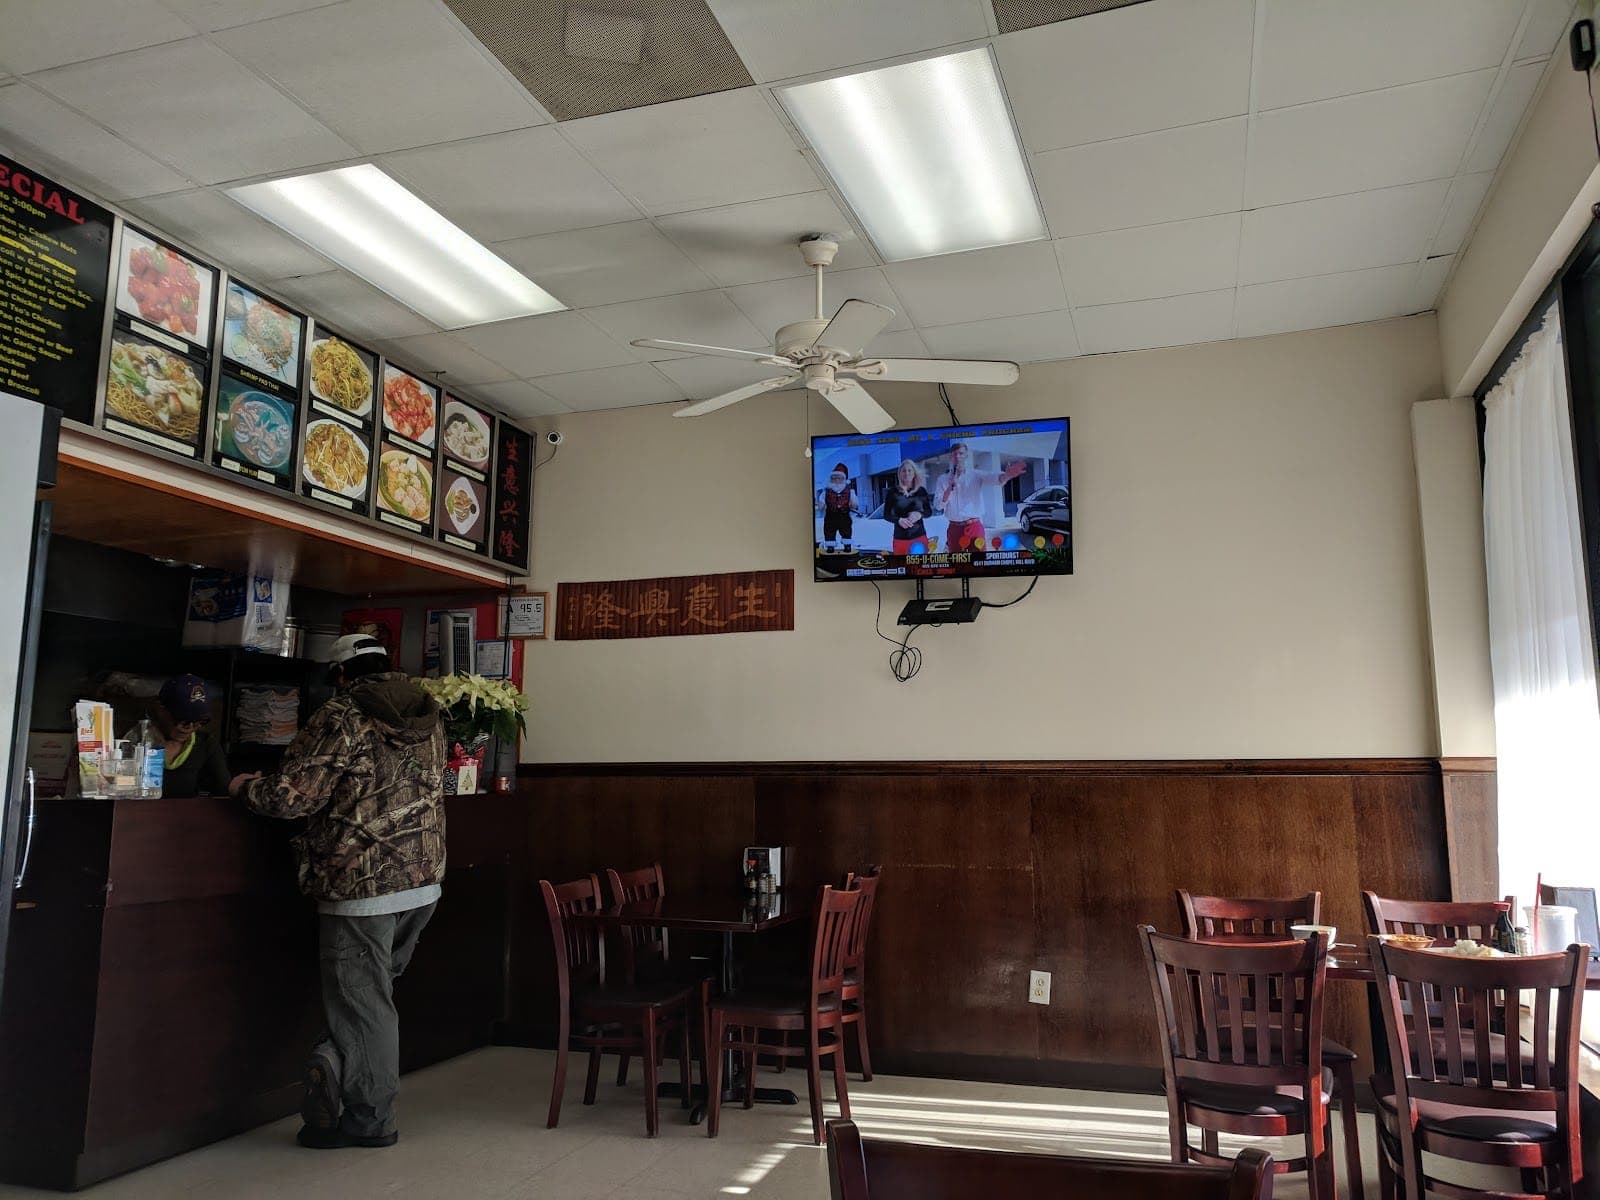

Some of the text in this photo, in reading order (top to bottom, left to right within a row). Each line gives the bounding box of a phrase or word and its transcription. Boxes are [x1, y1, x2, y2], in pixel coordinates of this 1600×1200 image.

[12, 196, 46, 220] 3:00pm
[19, 233, 50, 251] Chicken
[25, 267, 43, 279] Beef
[27, 258, 50, 272] Garlic
[7, 281, 38, 297] Chicken
[28, 279, 46, 291] Beef
[57, 292, 87, 308] Chicken
[11, 293, 42, 310] Chicken
[15, 316, 46, 332] Chicken
[32, 312, 63, 329] Chicken
[14, 327, 45, 343] Chicken
[8, 379, 40, 394] Broccoli
[905, 552, 972, 565] 855-U-COME-FIRST
